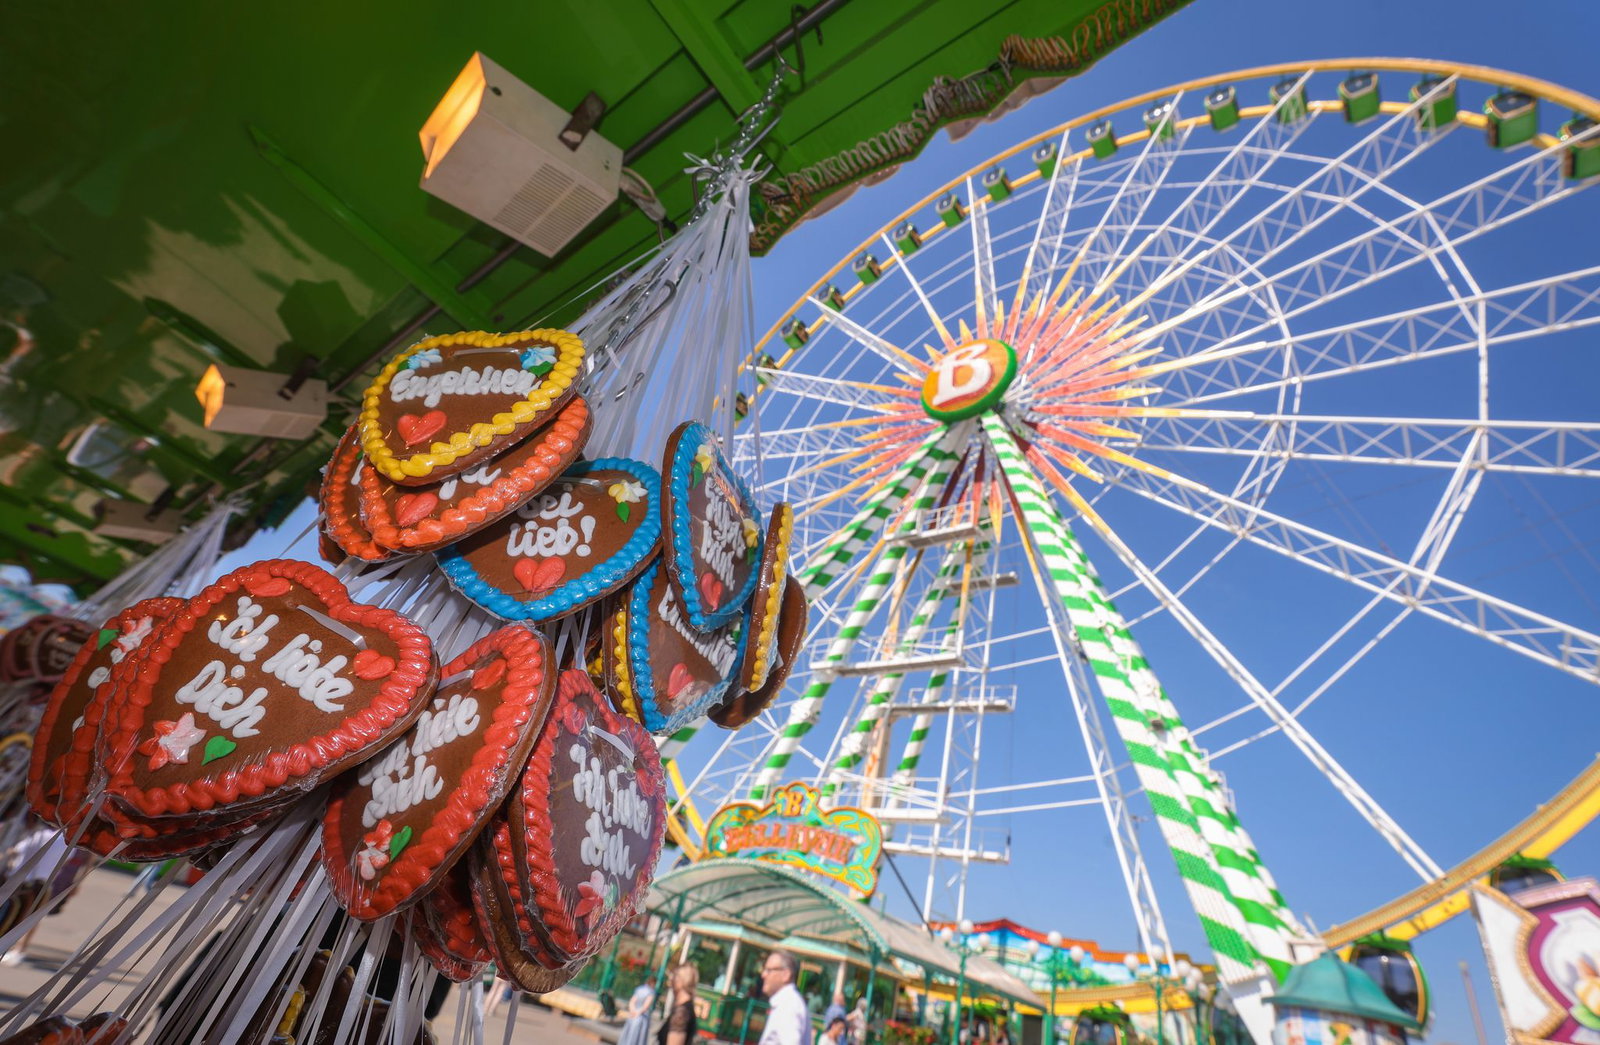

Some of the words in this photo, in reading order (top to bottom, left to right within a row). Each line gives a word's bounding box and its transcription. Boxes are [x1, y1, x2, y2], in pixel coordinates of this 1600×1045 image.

[932, 343, 990, 407] B
[261, 633, 354, 713] liebe
[783, 790, 803, 817] B
